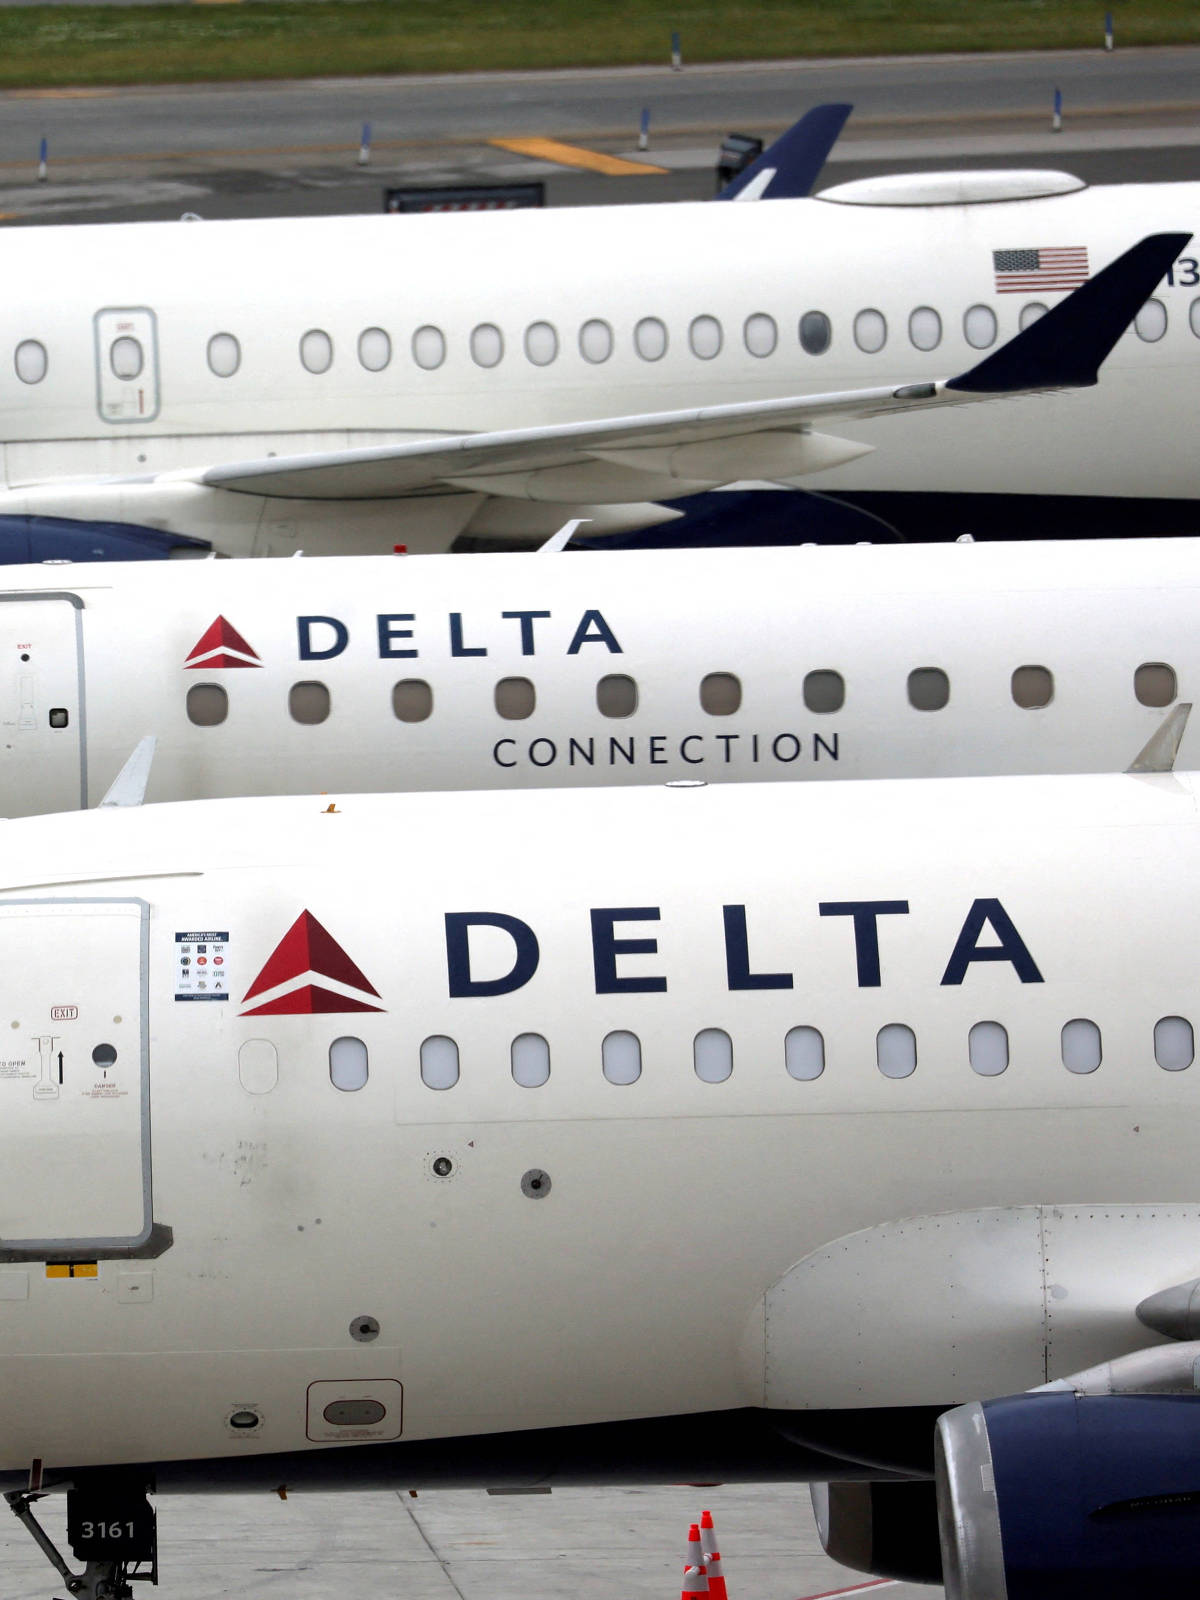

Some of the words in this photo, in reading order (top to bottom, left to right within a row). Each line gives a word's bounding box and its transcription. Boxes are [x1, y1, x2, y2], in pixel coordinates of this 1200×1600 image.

[298, 609, 622, 660] DELTA
[493, 732, 839, 767] CONNECTION
[445, 898, 1045, 998] DELTA
[54, 1008, 75, 1018] EXIT
[81, 1521, 134, 1538] 3161
